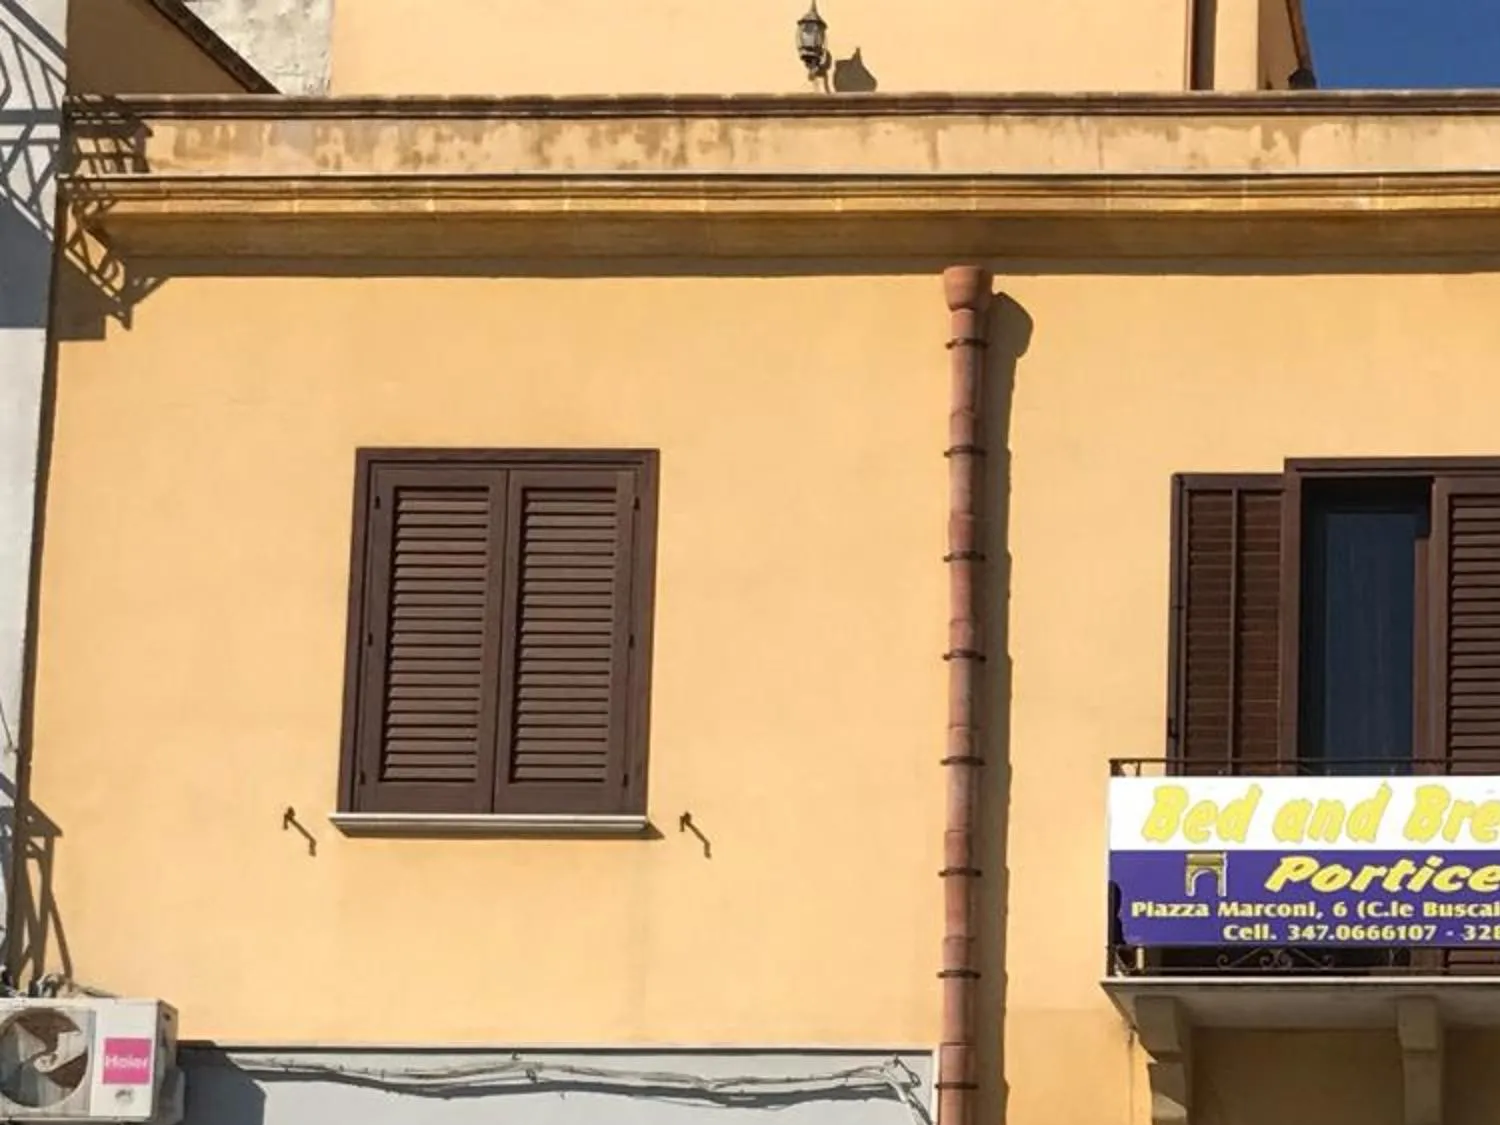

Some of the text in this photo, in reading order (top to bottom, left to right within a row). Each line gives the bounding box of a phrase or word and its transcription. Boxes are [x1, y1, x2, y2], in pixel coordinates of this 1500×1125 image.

[1140, 783, 1263, 844] Bed
[1271, 780, 1393, 844] and
[1131, 901, 1209, 917] Piazza
[1217, 901, 1324, 919] Marconi,
[1332, 901, 1348, 917] 6
[1357, 900, 1415, 918] (C.le
[1223, 924, 1277, 941] Cell.
[1287, 924, 1437, 941] 347.0666107
